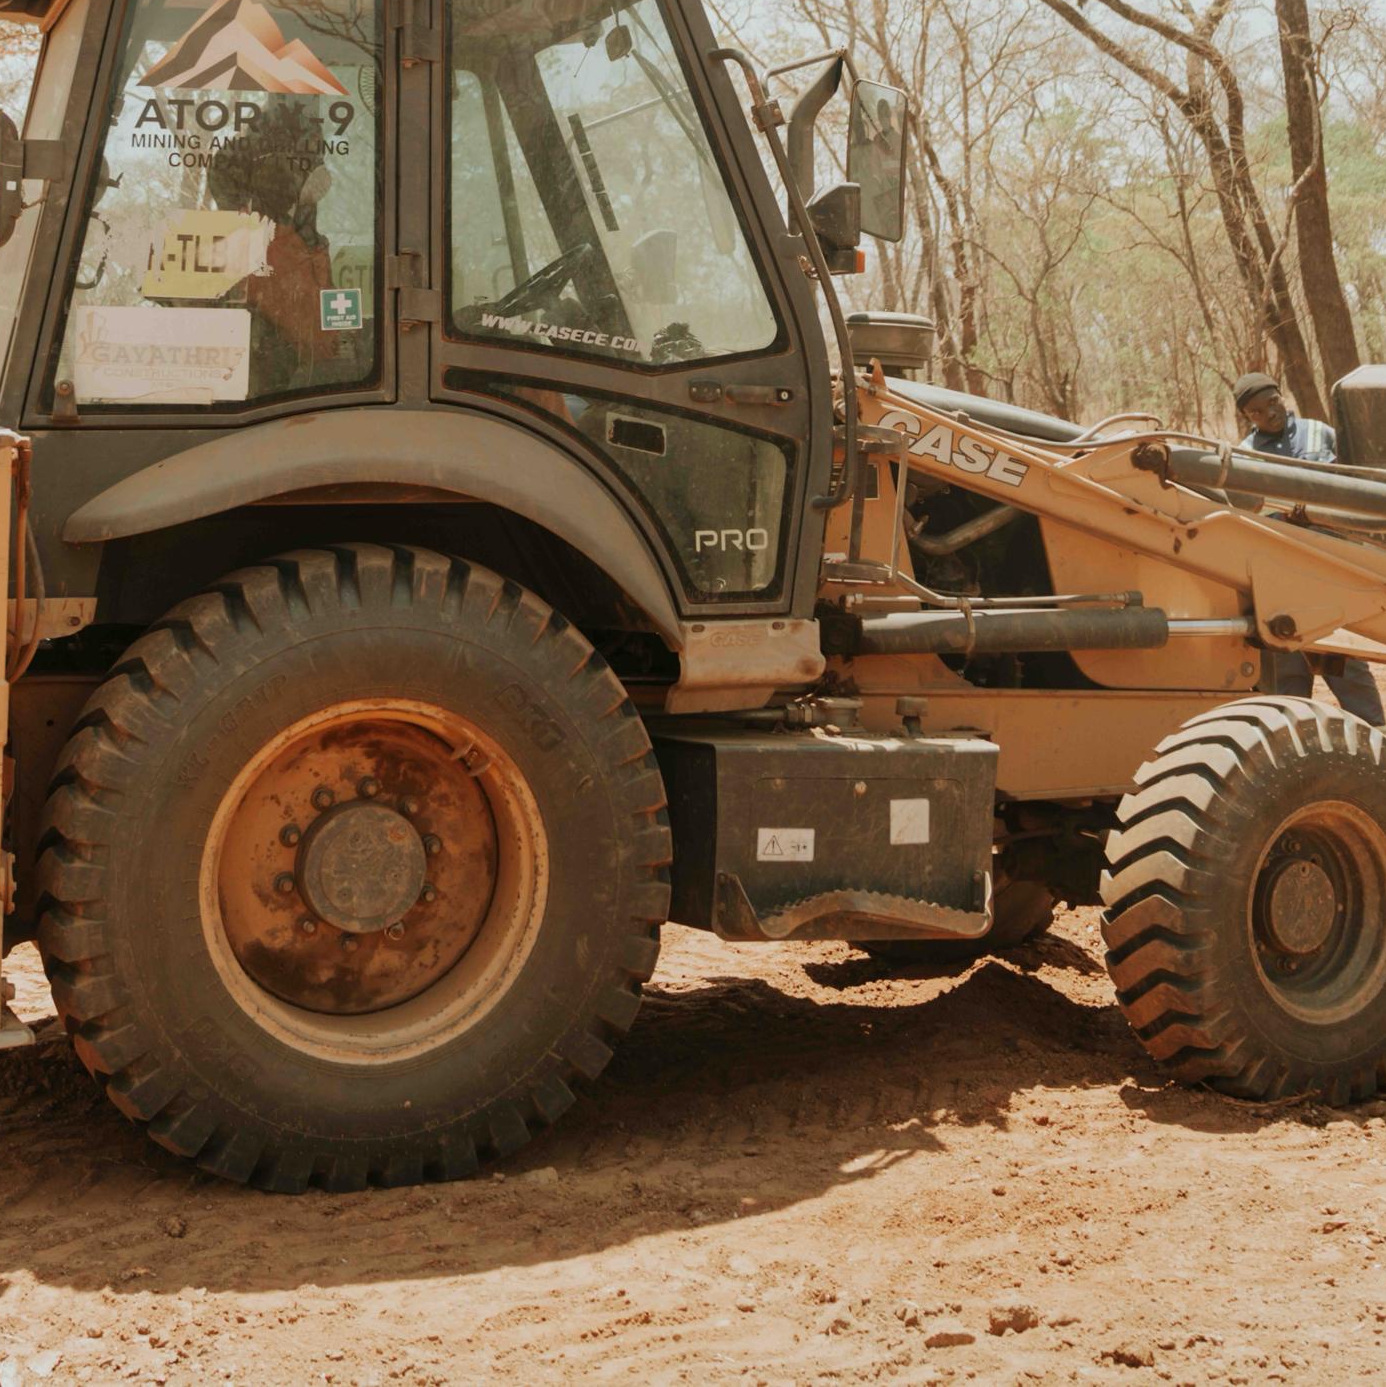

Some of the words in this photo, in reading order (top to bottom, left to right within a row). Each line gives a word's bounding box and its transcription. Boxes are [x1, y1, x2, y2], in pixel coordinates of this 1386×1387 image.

[134, 98, 261, 133] ATOR
[131, 133, 201, 150] MINING
[209, 135, 251, 151] AND
[877, 410, 1030, 487] CASE
[695, 528, 769, 553] PRO
